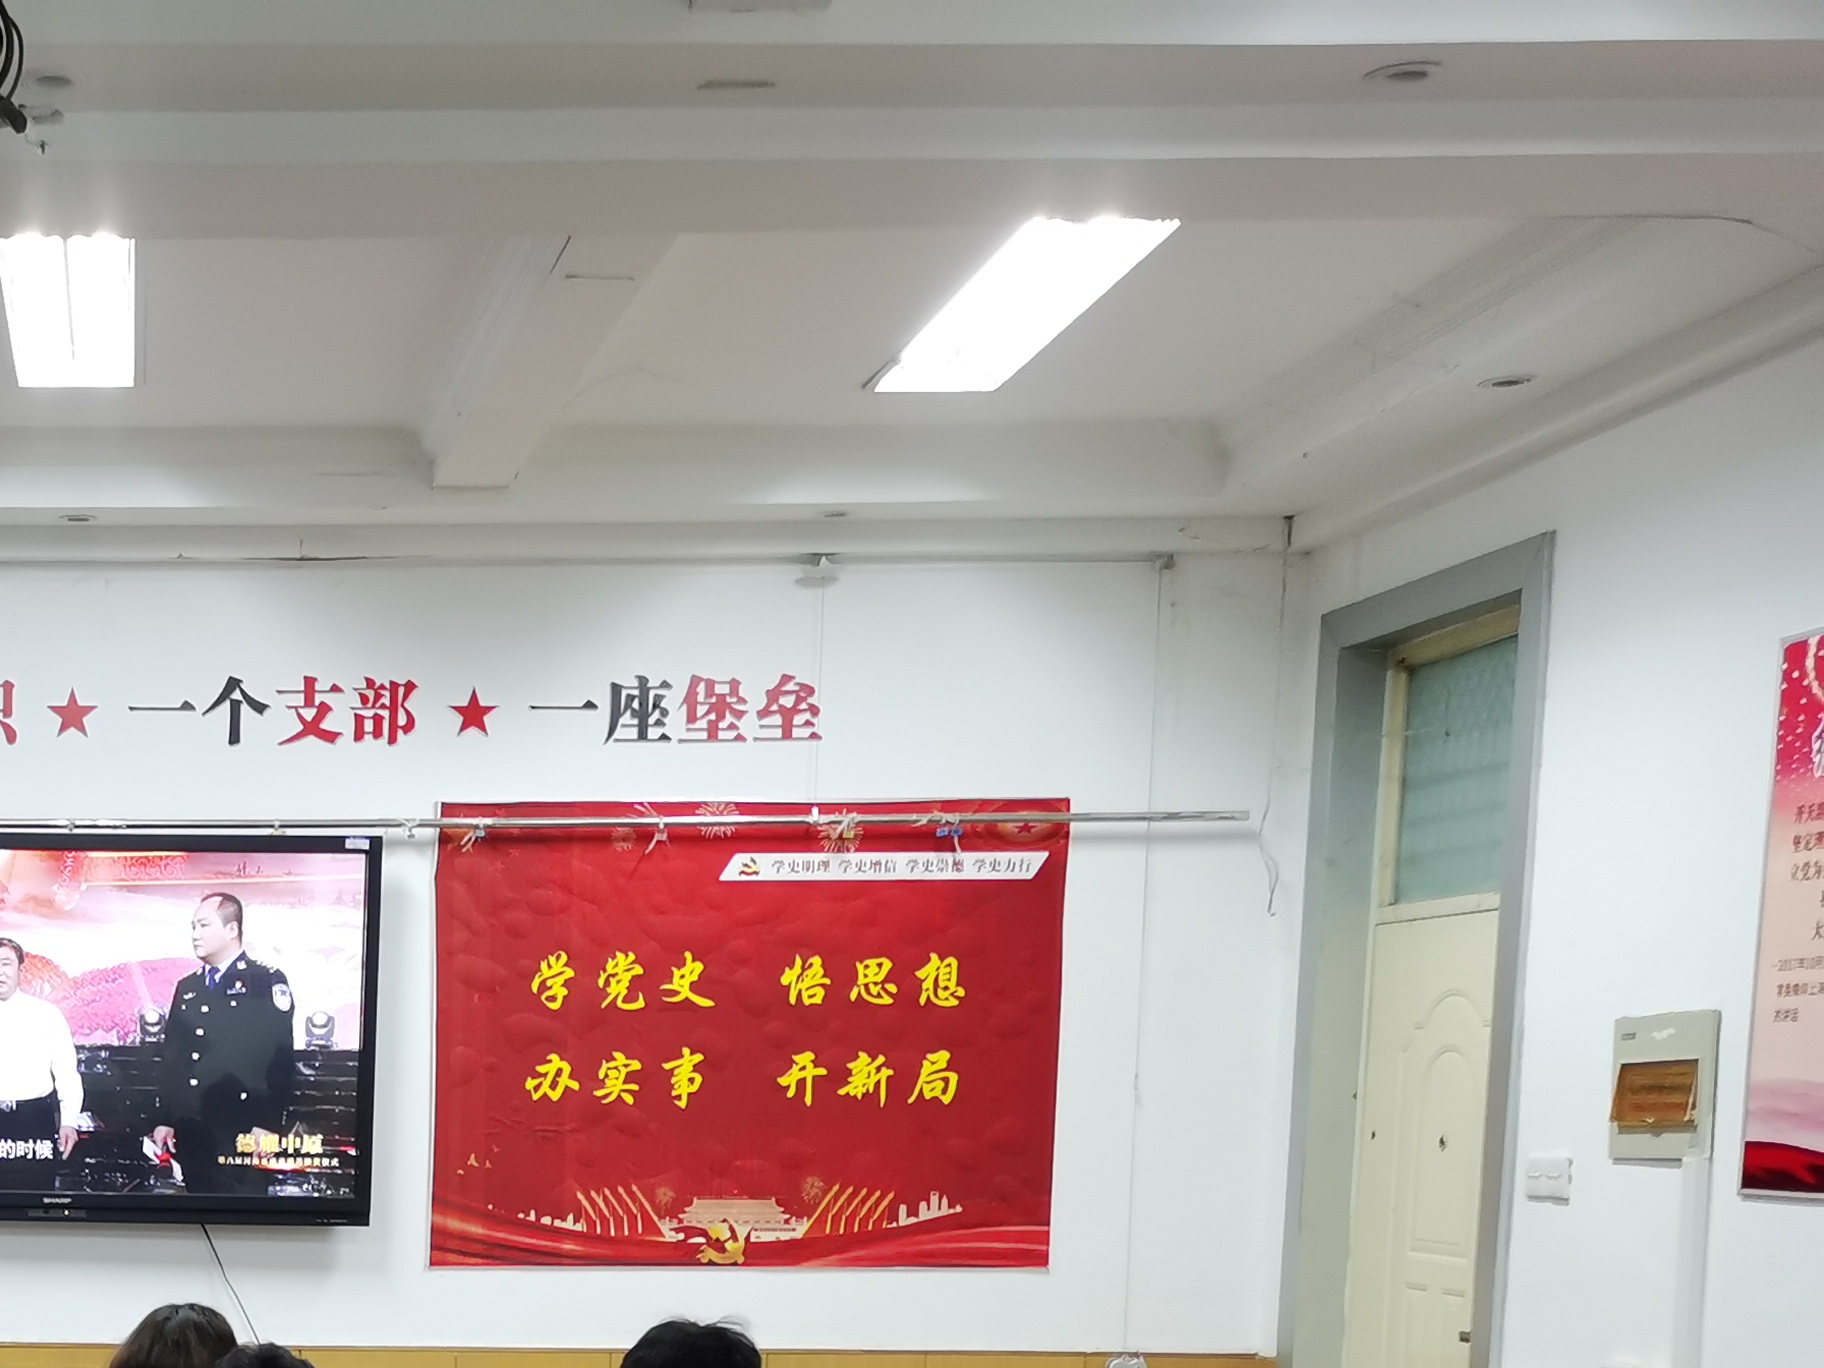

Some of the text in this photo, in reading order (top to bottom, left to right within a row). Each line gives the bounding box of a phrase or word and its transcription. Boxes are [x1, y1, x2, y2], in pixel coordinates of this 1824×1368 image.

[128, 675, 419, 747] 一个支部
[528, 674, 823, 746] 一座堡垒
[531, 950, 966, 1010] 学党史 悟思想
[524, 1047, 959, 1110] 办实事 开新局
